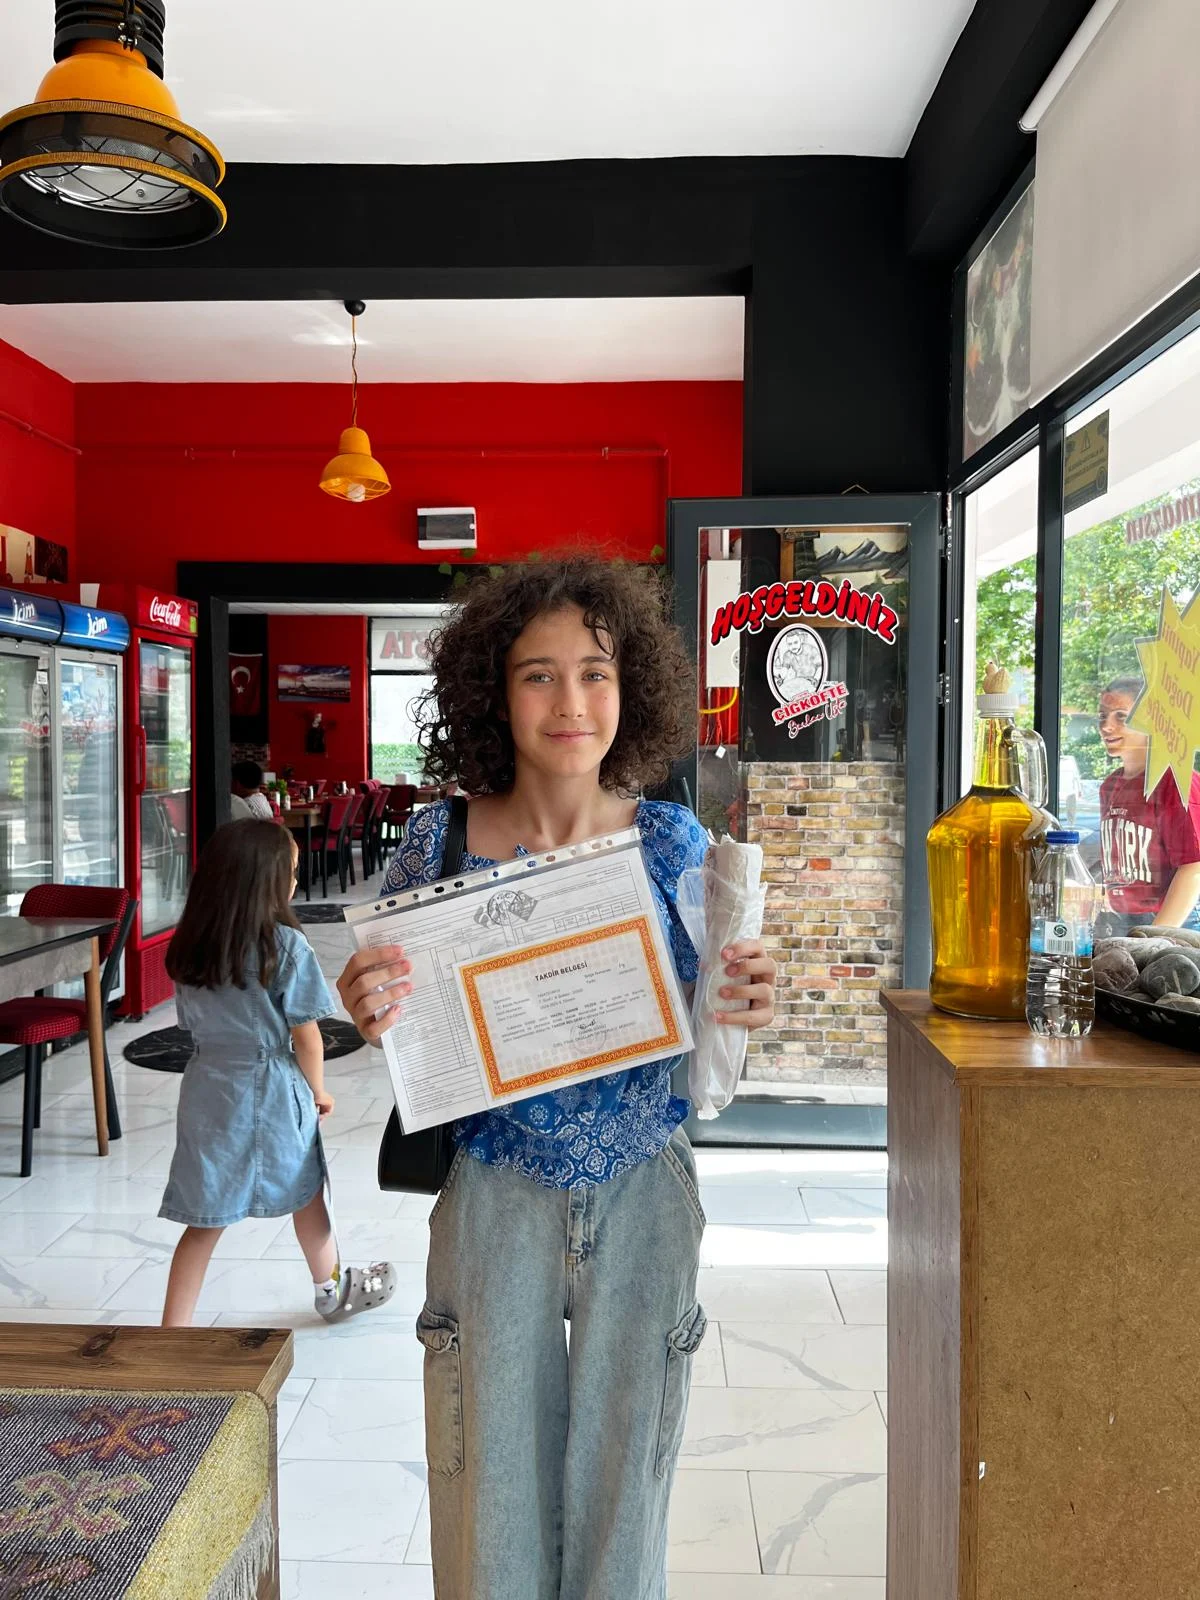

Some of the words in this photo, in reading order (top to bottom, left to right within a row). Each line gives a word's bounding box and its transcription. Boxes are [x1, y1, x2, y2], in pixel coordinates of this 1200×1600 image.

[709, 579, 899, 646] HOŞGELDİNİZ
[534, 968, 560, 982] TAKDİR
[560, 961, 588, 976] BELGESİ
